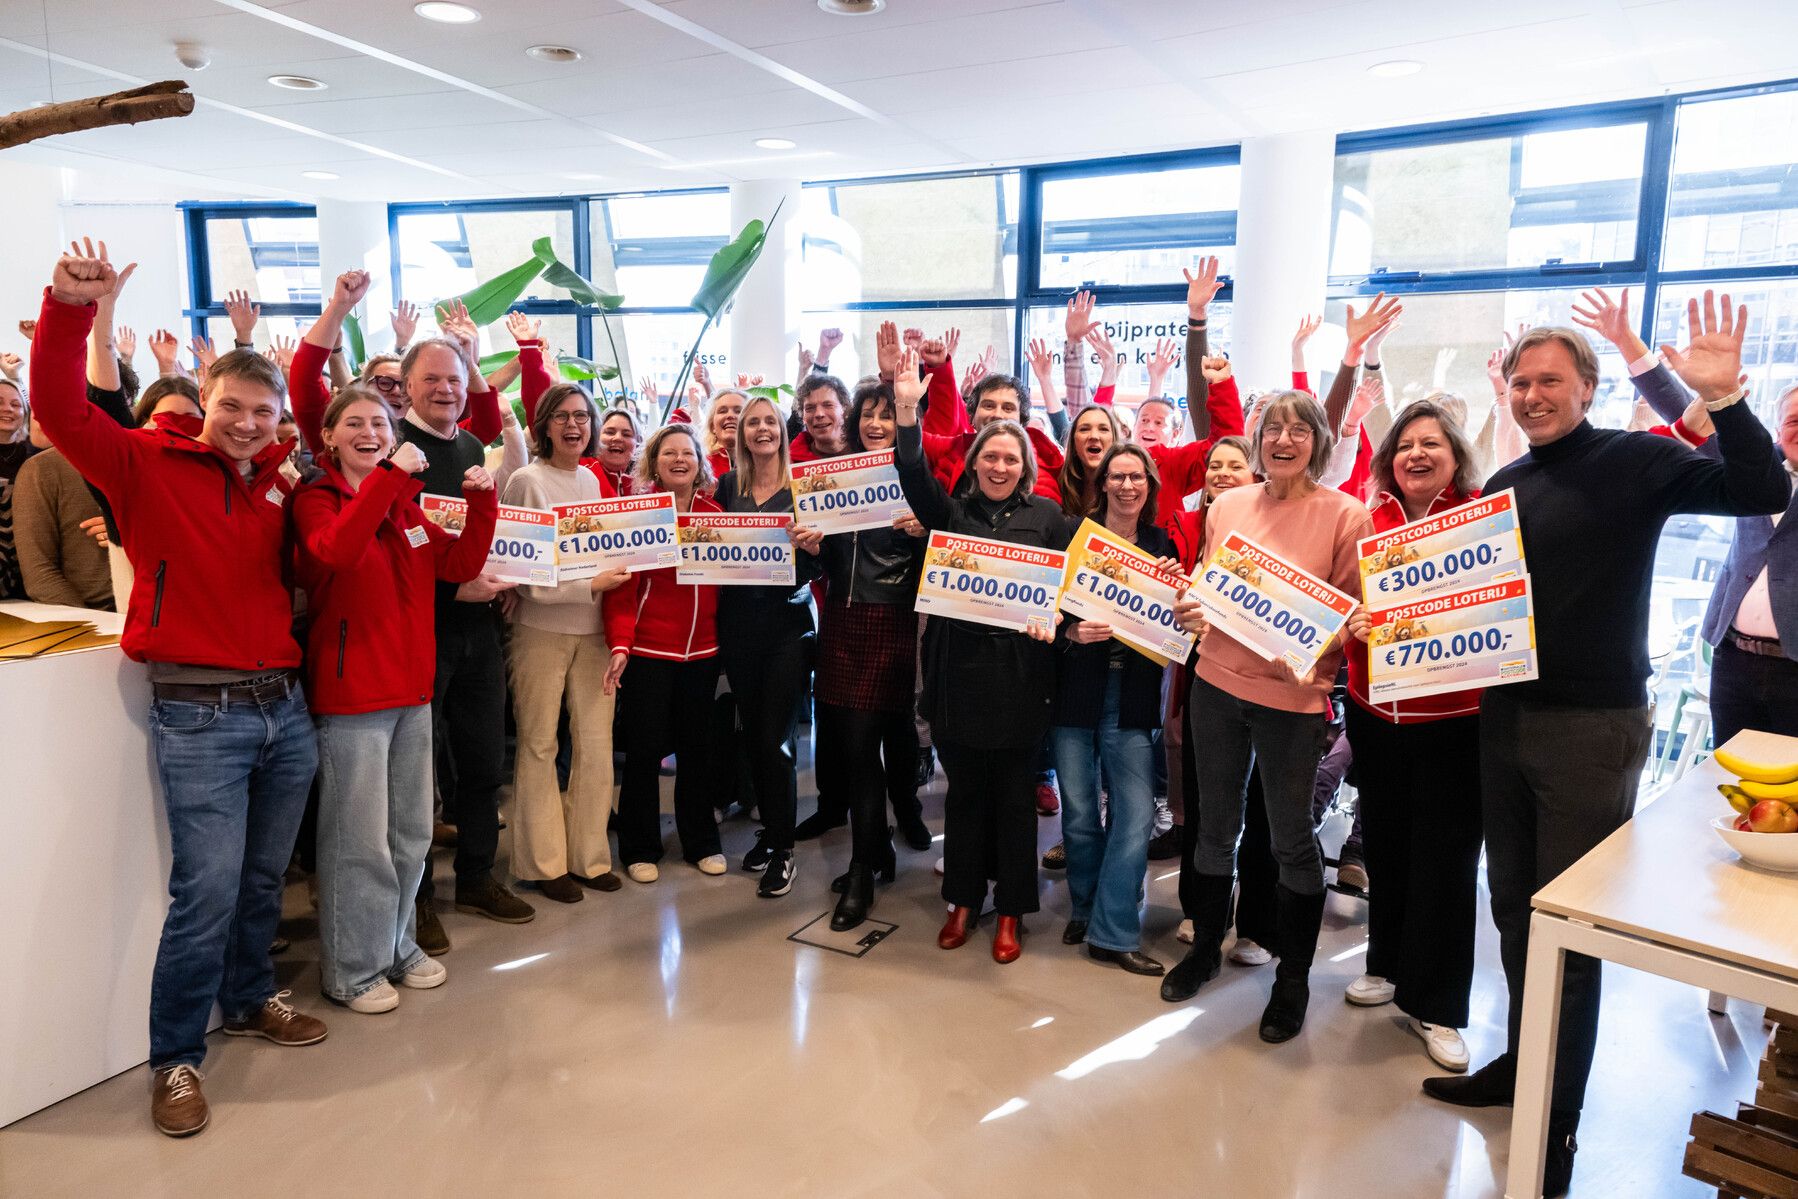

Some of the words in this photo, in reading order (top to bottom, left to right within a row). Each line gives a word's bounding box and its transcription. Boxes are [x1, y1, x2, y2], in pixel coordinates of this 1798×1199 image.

[1105, 321, 1188, 341] bijprate
[683, 350, 726, 364] fisse
[803, 459, 853, 476] POSTCODE
[854, 454, 892, 469] LOTERIJ
[439, 501, 468, 512] POST
[500, 510, 540, 523] LOTERIJ
[566, 502, 620, 517] POSTCODE
[621, 498, 660, 511] LOTERIJ
[689, 517, 740, 528] POSTCODE
[741, 517, 779, 526] LOTERIJ
[1376, 520, 1440, 551] POSTCODE
[1442, 504, 1493, 527] LOTERIJ
[946, 538, 1004, 557] POSTCODE
[1005, 548, 1050, 565] LOTERIJ
[1101, 544, 1157, 575] POSTCODE
[1156, 570, 1190, 589] LOTER
[1239, 543, 1294, 582] POSTCODE
[1291, 573, 1337, 606] LOTERIJ
[1386, 597, 1451, 621] POSTCODE
[1454, 586, 1507, 607] LOTERIJ
